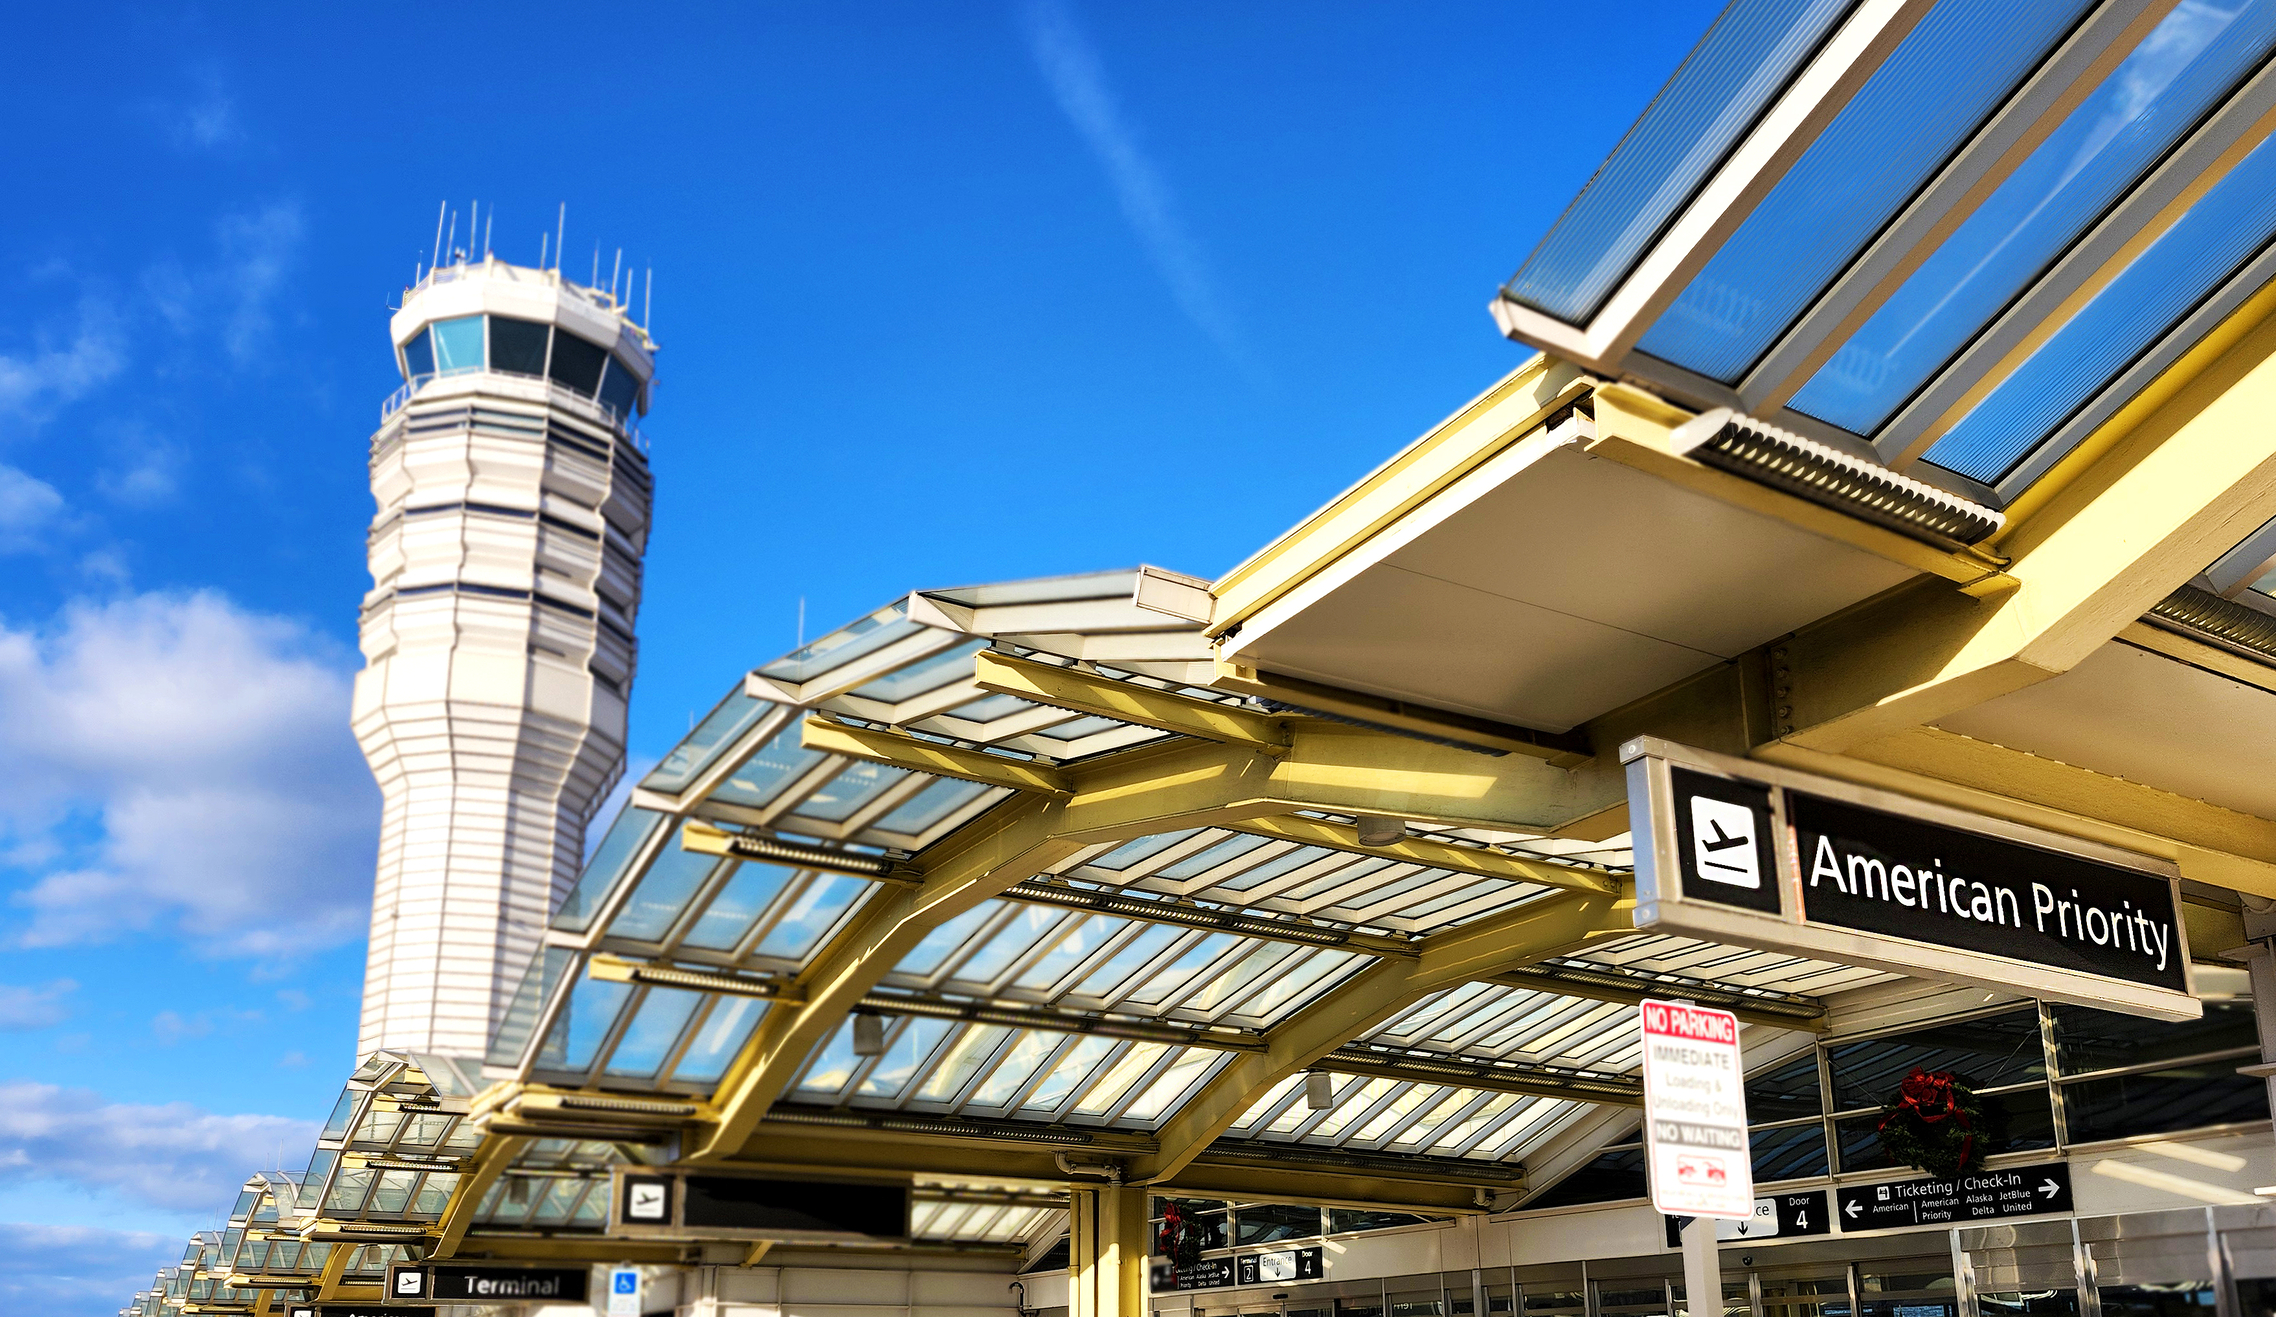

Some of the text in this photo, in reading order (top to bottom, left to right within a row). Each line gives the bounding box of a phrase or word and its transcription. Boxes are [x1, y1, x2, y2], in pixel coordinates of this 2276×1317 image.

[1810, 835, 2168, 971] American Priority
[1646, 1006, 1733, 1041] NO PARKING
[1654, 1045, 1730, 1070] IMMEDIATE
[1665, 1072, 1722, 1095] Loading &
[1652, 1095, 1739, 1119] Unloading Only
[1656, 1123, 1741, 1148] NO WAITING
[1894, 1173, 2021, 1199] Ticketing / Check-In
[1789, 1197, 1810, 1206] Door
[1872, 1203, 1909, 1213] American
[1921, 1189, 2031, 1209] American Alaska JetBlue
[1796, 1210, 1808, 1229] 4
[1922, 1202, 2032, 1220] Priority Delta United
[1263, 1256, 1292, 1266] Entrance
[1305, 1260, 1311, 1275] 4
[1246, 1268, 1251, 1280] 2
[464, 1275, 560, 1295] Terminal
